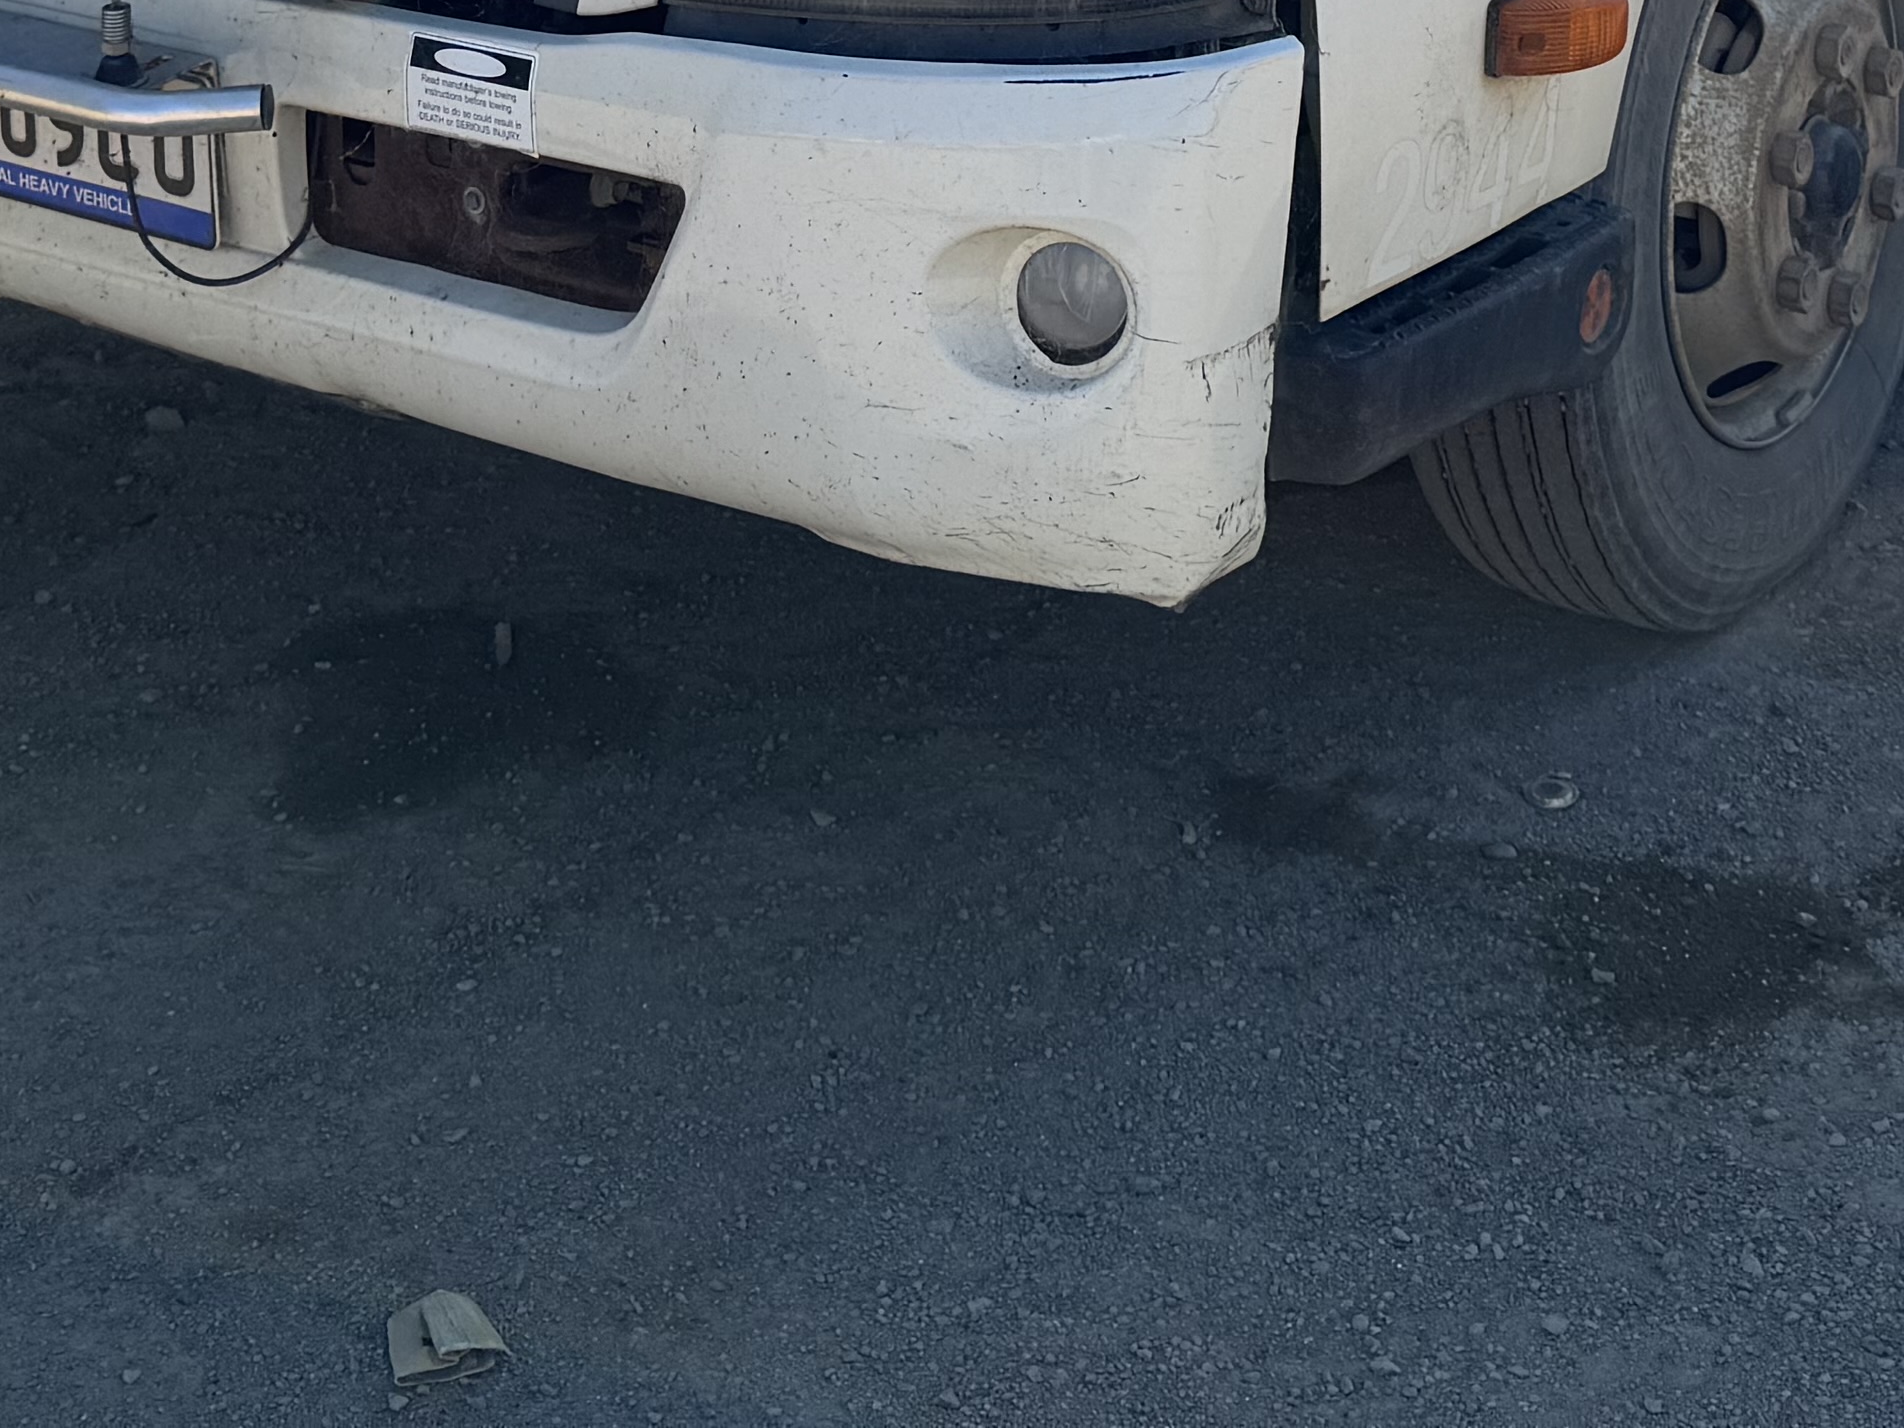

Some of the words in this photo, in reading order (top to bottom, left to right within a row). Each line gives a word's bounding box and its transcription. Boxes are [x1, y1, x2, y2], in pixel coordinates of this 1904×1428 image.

[421, 73, 440, 84] Read
[494, 90, 517, 103] towing
[424, 87, 463, 102] instructions
[464, 95, 487, 108] before
[489, 101, 512, 115] towing
[417, 99, 441, 113] Failure
[443, 105, 450, 114] to
[451, 107, 461, 117] do
[462, 110, 472, 119] so
[473, 112, 492, 123] could
[494, 117, 514, 129] result
[418, 111, 444, 123] DEATH
[446, 118, 454, 126] or
[456, 119, 490, 135] SERIOUS
[19, 172, 70, 200] HEAVY
